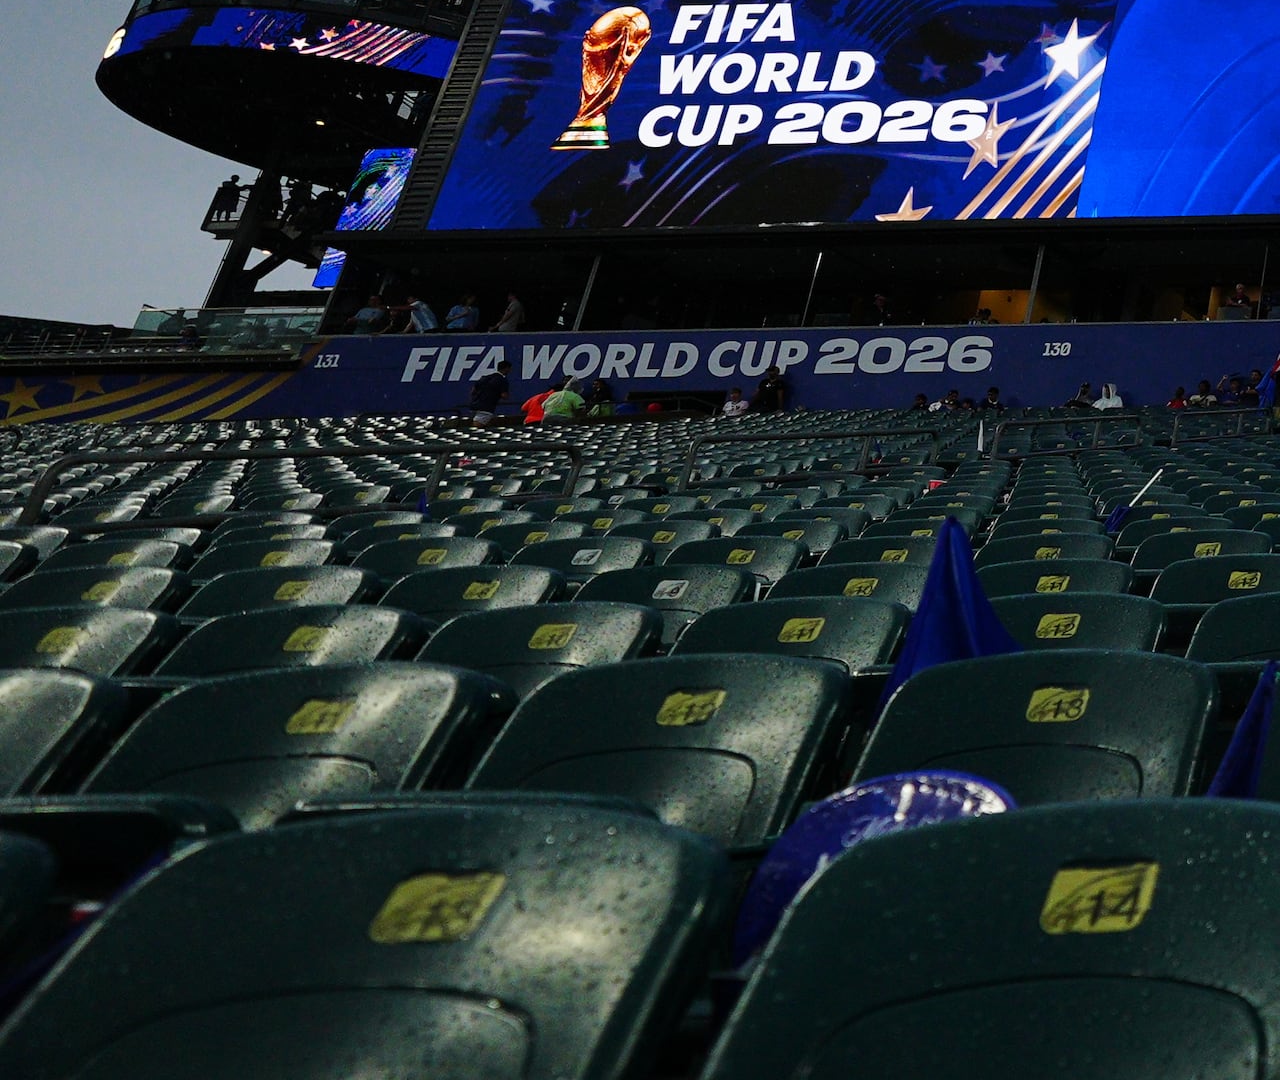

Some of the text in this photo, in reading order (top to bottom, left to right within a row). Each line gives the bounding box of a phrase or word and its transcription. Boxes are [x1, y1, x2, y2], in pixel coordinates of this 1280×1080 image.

[668, 3, 795, 44] FIFA
[659, 50, 876, 95] WORLD
[638, 99, 988, 147] CUP 2026
[314, 354, 340, 368] 131
[400, 335, 994, 383] FIFA WORLD CUP 2026
[1042, 342, 1071, 357] 130
[1242, 576, 1258, 588] 12
[1053, 623, 1075, 636] 12
[1053, 699, 1084, 719] 13
[1090, 889, 1142, 924] 14
